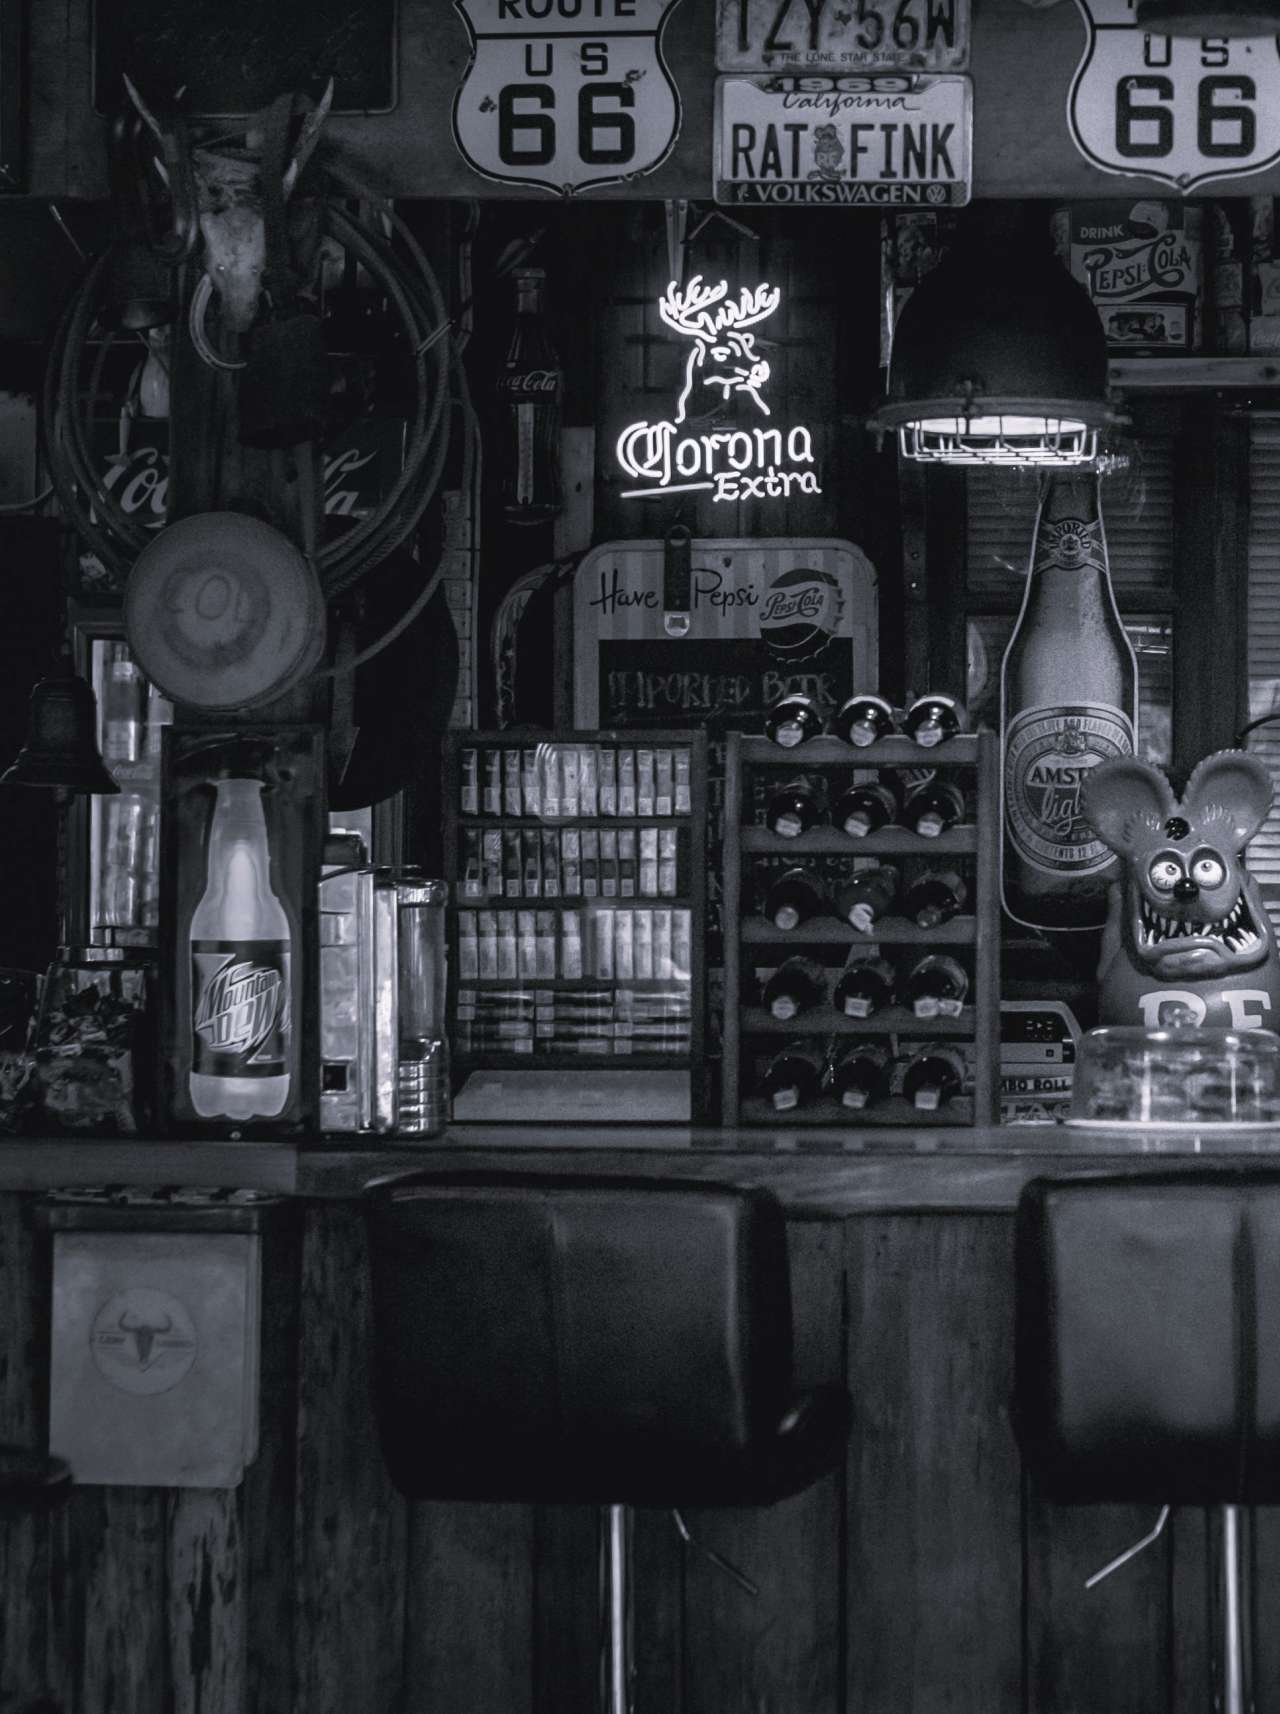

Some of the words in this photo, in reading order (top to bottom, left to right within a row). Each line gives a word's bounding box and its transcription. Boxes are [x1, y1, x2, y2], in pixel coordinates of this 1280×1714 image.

[806, 53, 834, 63] LONE
[840, 53, 867, 63] STAR
[499, 82, 636, 167] 66
[782, 92, 921, 118] California
[1116, 75, 1256, 158] 66
[732, 123, 809, 179] RAT
[850, 123, 956, 179] FINK
[755, 183, 922, 204] VOLKSWAGEN
[1080, 223, 1125, 239] DRINK
[615, 420, 814, 487] Corona
[712, 465, 823, 502] Extra
[590, 568, 659, 614] Have
[690, 568, 759, 616] Pepsi
